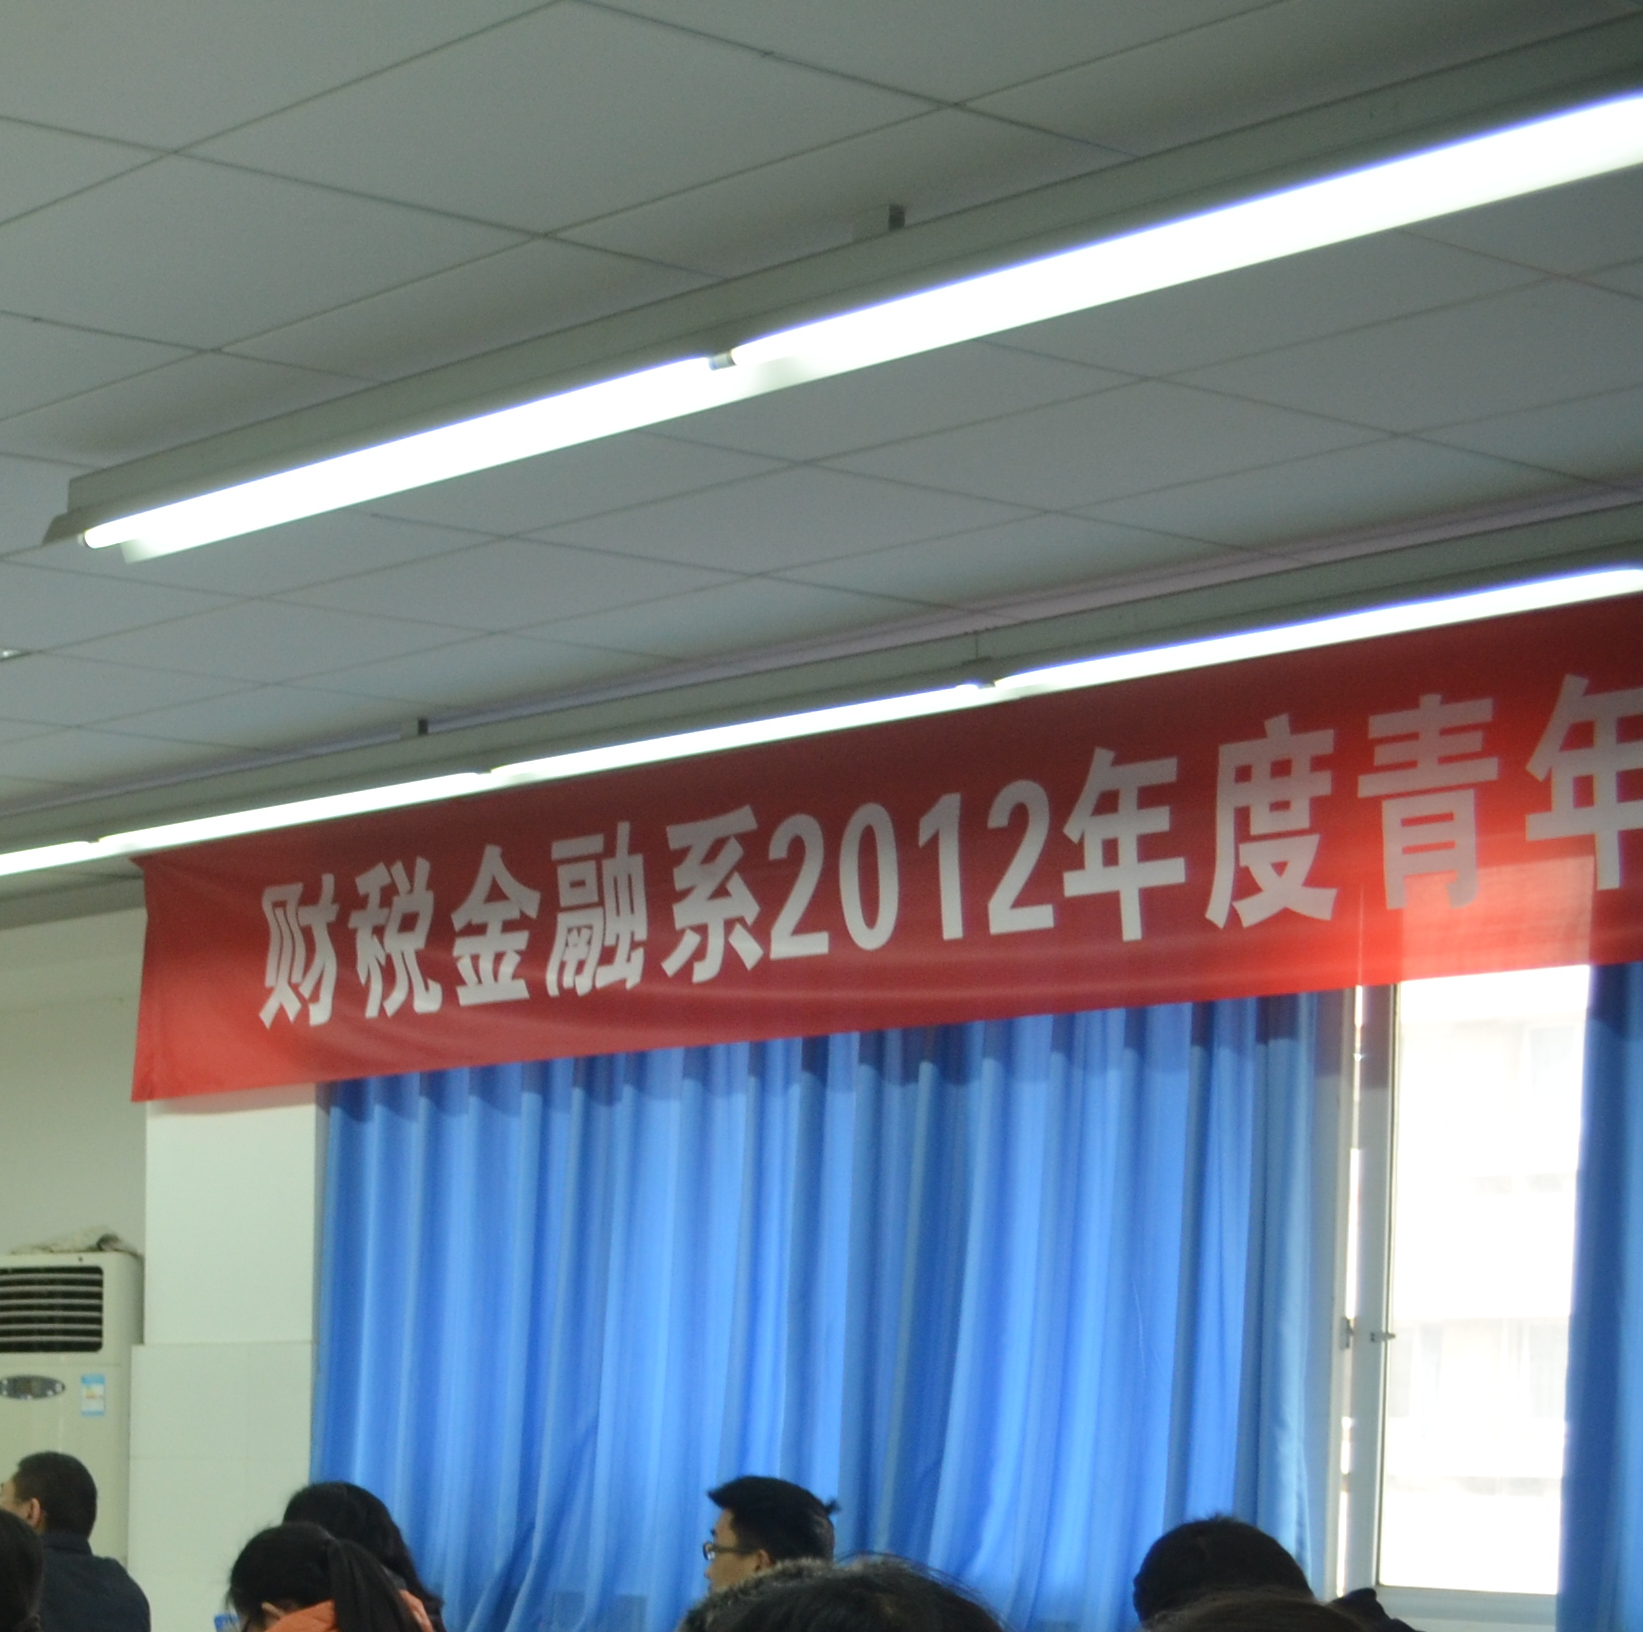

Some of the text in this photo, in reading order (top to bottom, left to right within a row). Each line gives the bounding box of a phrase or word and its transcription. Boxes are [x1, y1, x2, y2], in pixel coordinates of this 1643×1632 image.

[258, 673, 1643, 1030] 财税金融系2012年度青年
